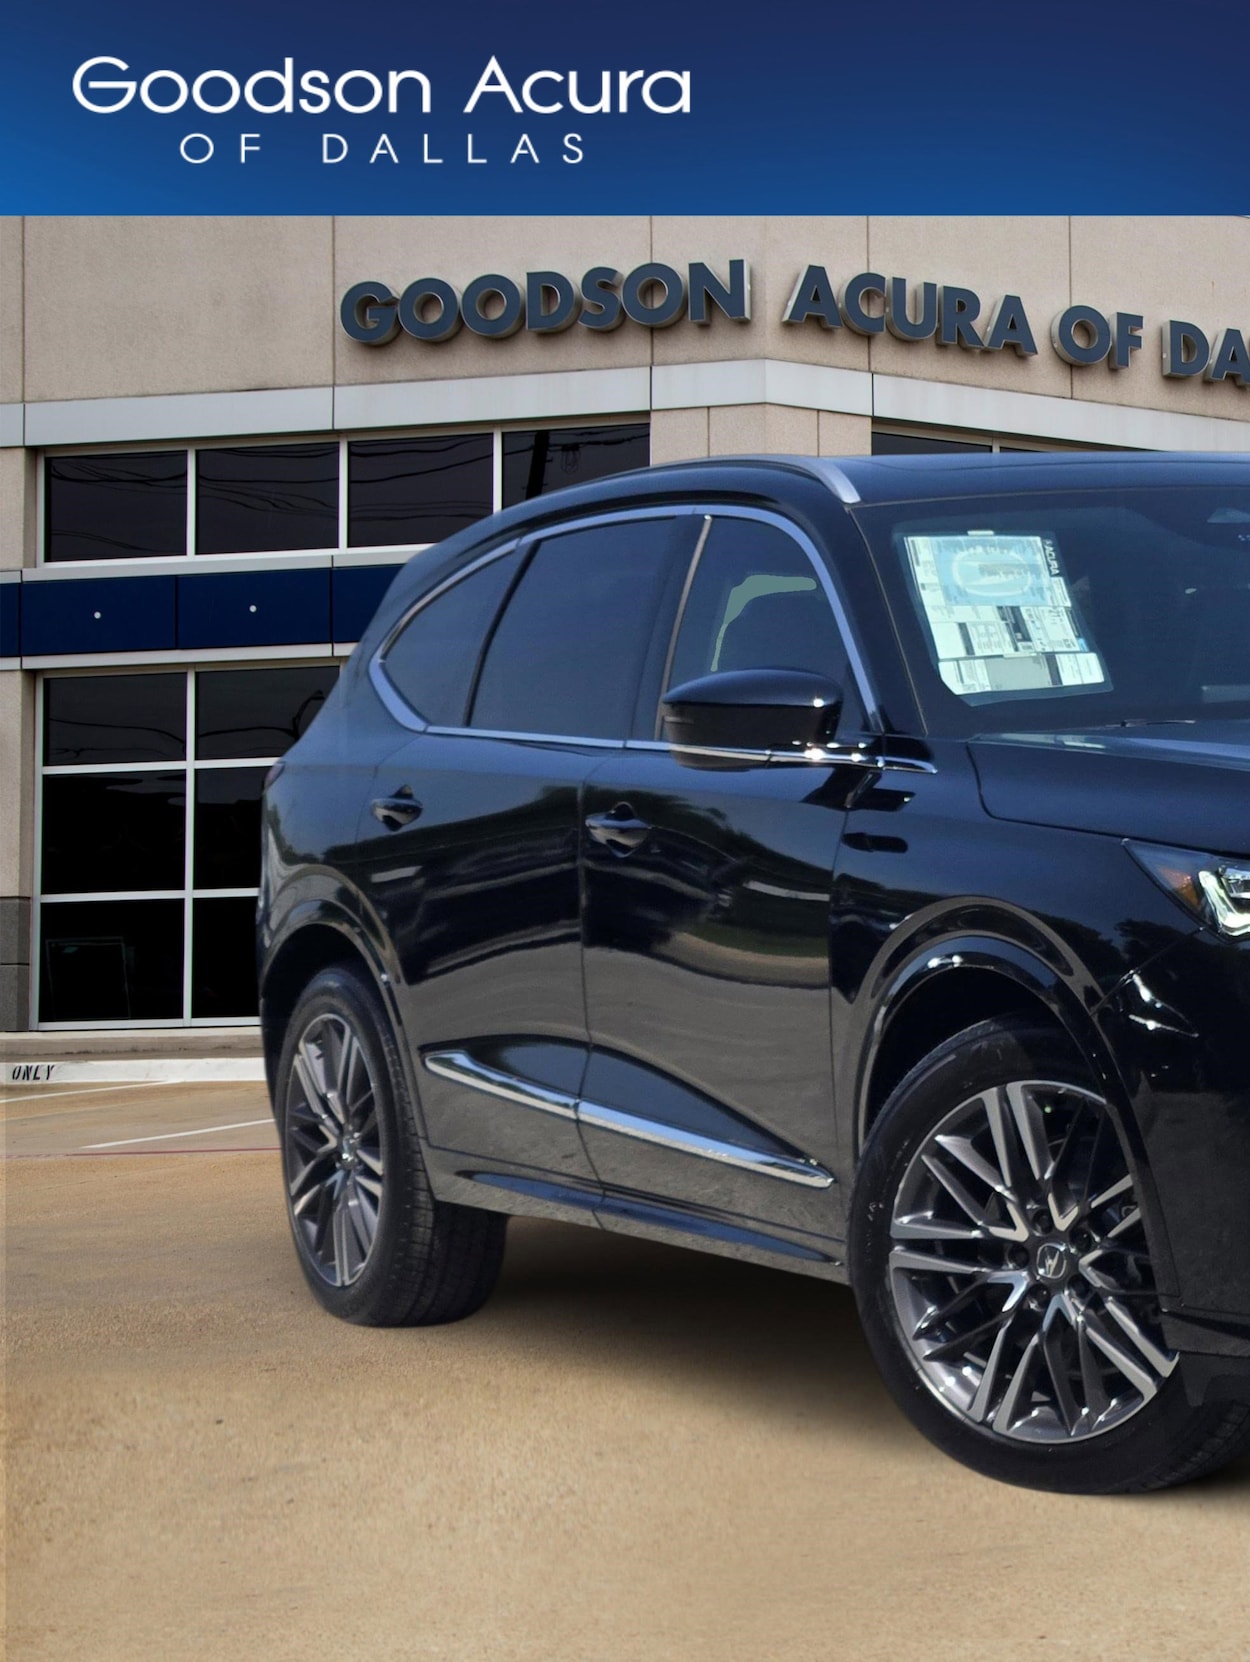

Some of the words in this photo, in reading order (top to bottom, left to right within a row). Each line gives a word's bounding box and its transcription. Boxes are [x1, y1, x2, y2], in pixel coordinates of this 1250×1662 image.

[340, 259, 751, 346] GOODSON
[783, 265, 1038, 357] ACURA
[1050, 305, 1144, 369] OF
[1044, 545, 1060, 576] ACURA
[11, 1064, 55, 1081] ONLY
